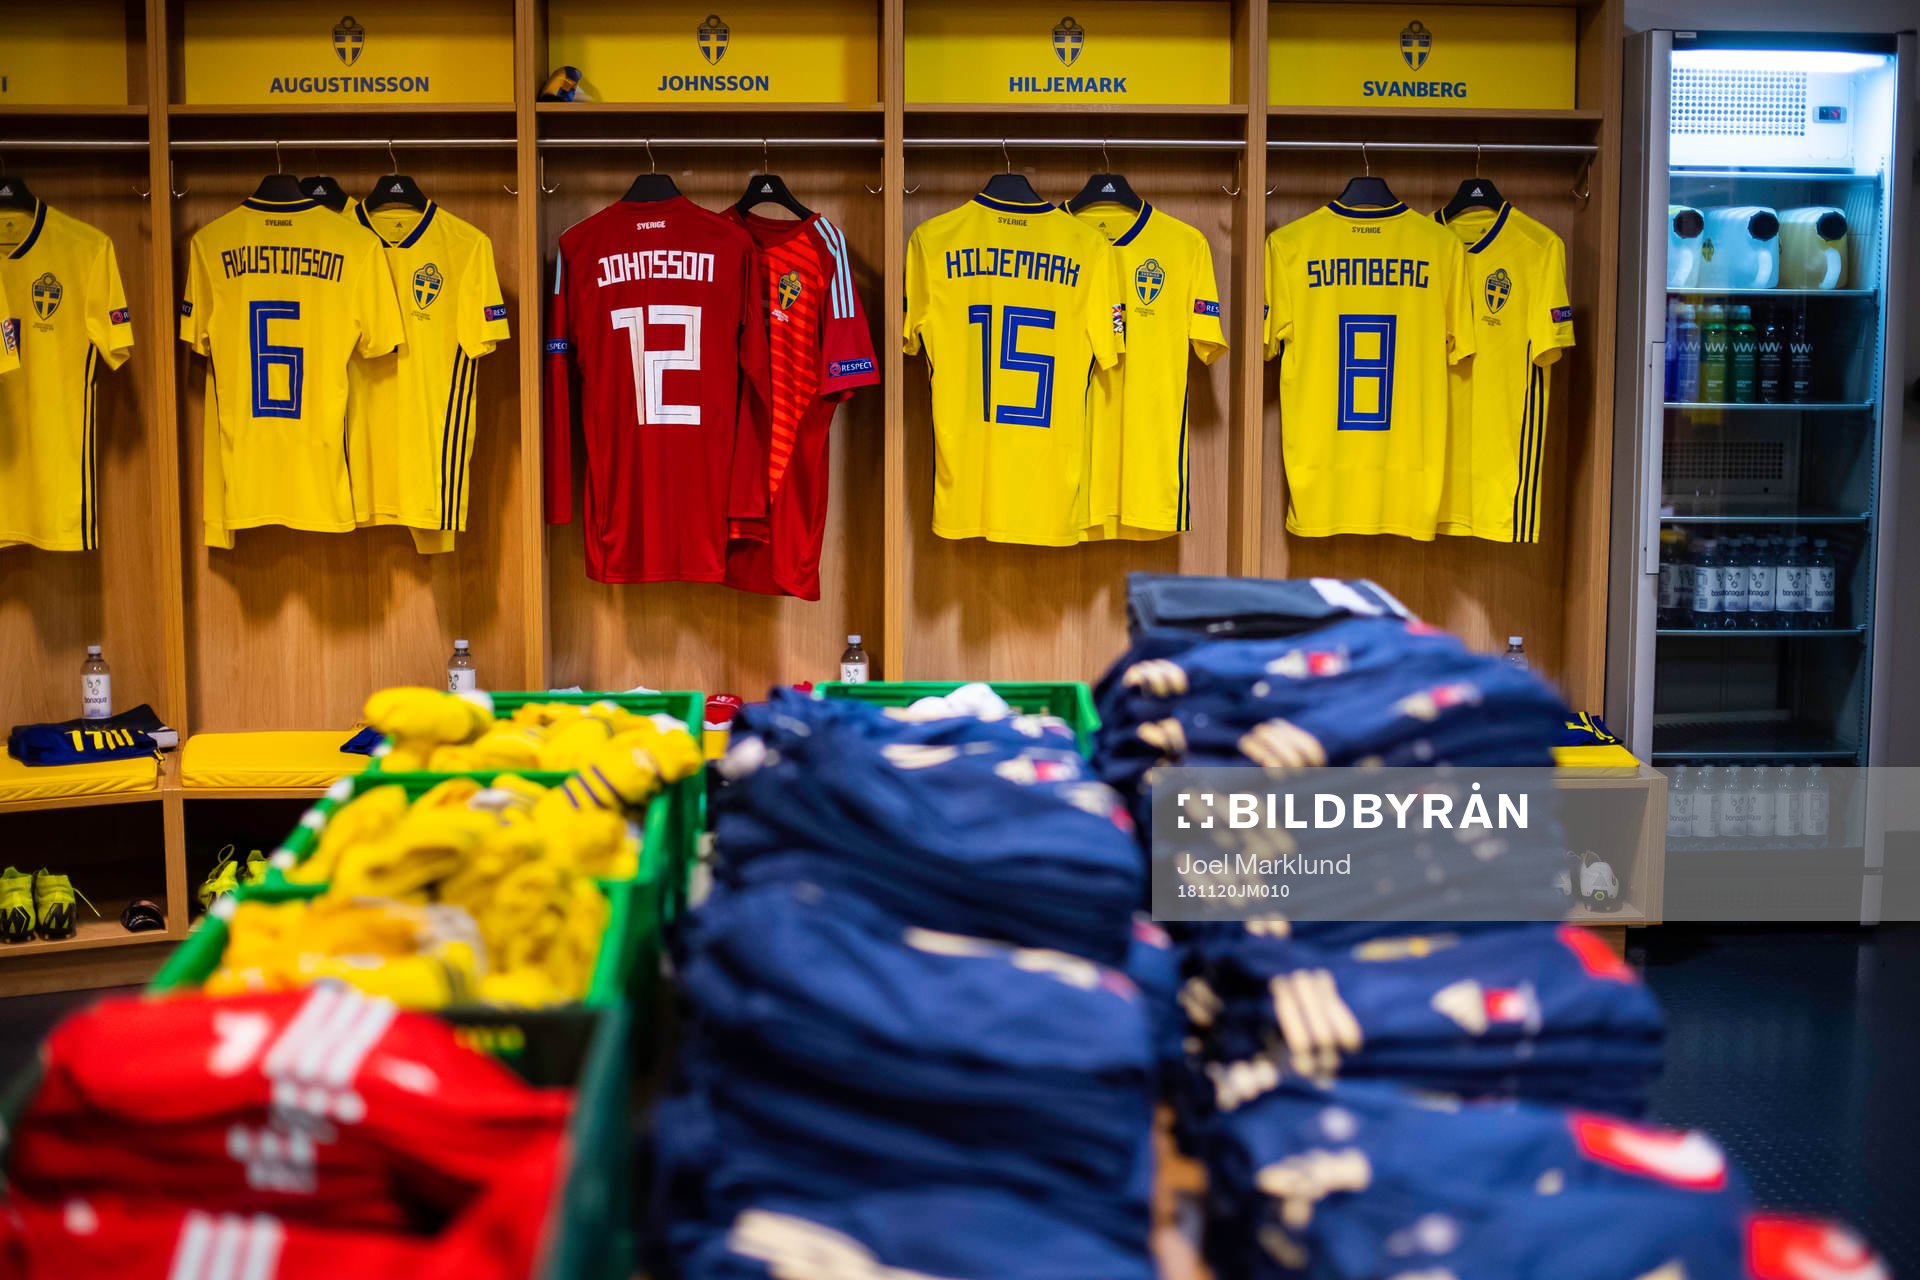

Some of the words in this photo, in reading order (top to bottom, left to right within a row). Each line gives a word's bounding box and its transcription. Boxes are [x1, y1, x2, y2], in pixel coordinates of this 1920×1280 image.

[269, 76, 429, 93] AUGUSTINSSON
[657, 75, 769, 92] JOHNSSON
[1009, 76, 1127, 93] HILJEMARK
[1363, 80, 1467, 98] SVANBERG
[264, 218, 293, 227] SVERIGE
[636, 220, 666, 231] SVERIGE
[997, 216, 1028, 227] SVERIGE
[1351, 226, 1382, 234] SVERIGE
[220, 245, 345, 283] AUGUSTINSSON
[596, 249, 715, 288] JOHNSSON
[945, 247, 1081, 288] HILJEMARK
[1307, 258, 1430, 289] SVANBERG
[248, 300, 304, 420] 6
[610, 304, 702, 425] 12
[841, 360, 873, 372] RESPECT
[968, 304, 1056, 428] 15
[1337, 314, 1397, 431] 8
